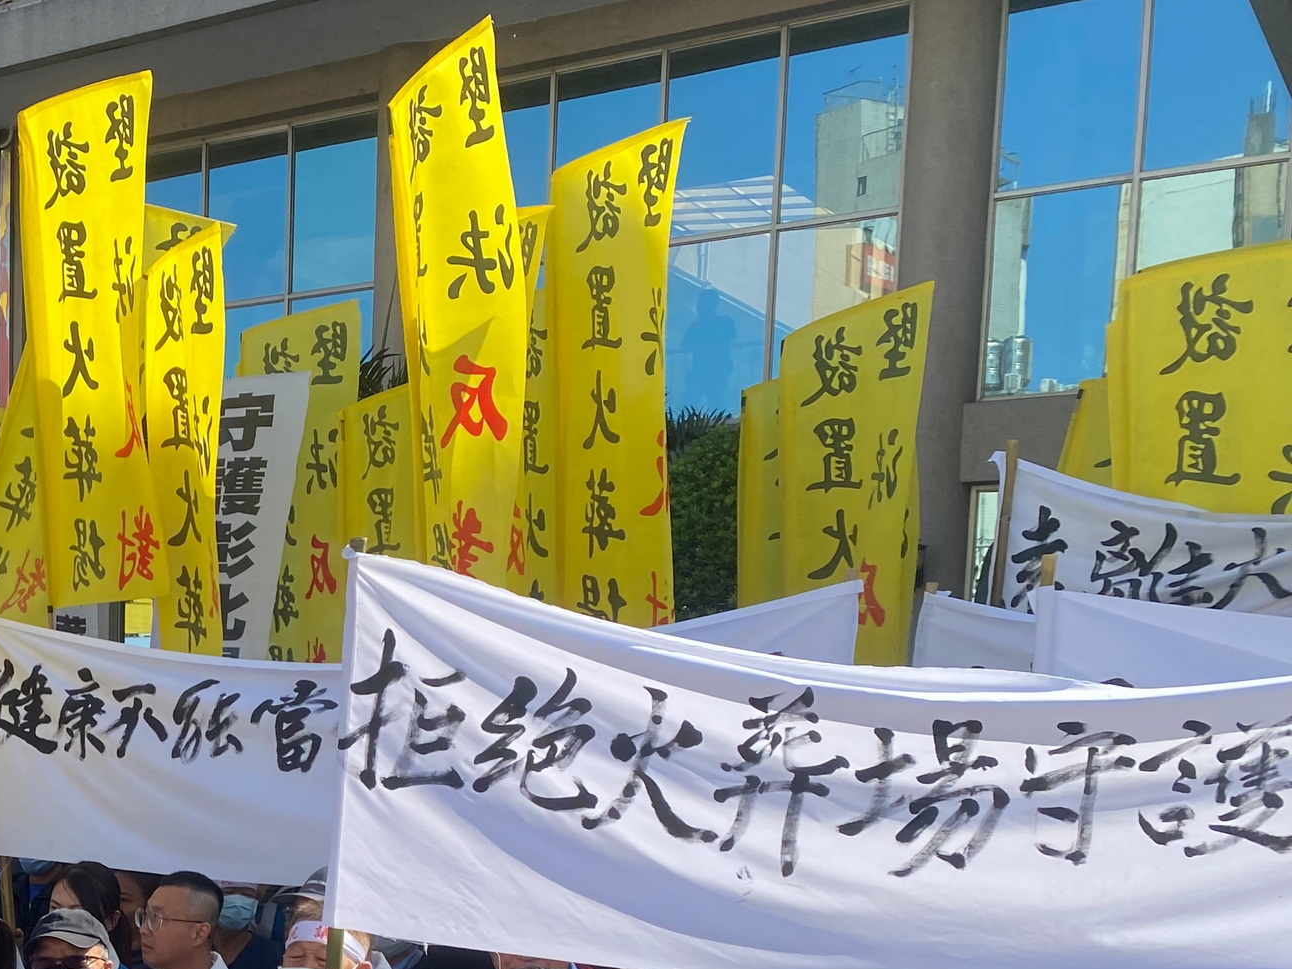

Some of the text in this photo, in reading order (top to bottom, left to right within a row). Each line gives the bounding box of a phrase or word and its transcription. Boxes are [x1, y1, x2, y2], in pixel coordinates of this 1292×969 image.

[216, 393, 275, 658] 守護彰化
[337, 628, 1292, 878] 拒絕火葬場守護
